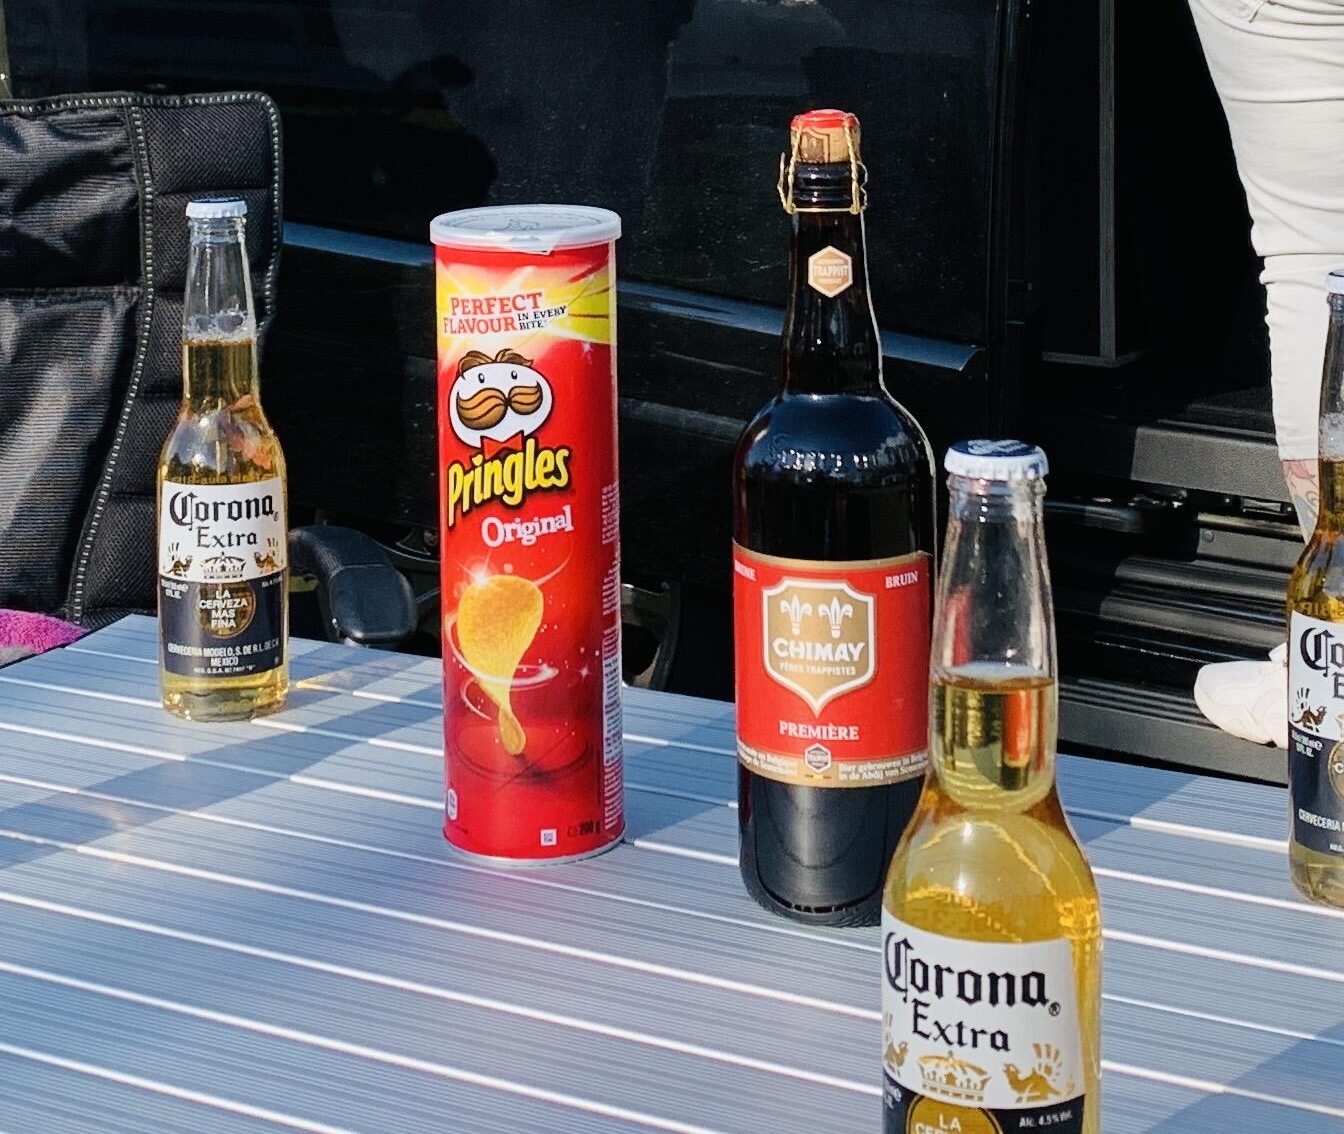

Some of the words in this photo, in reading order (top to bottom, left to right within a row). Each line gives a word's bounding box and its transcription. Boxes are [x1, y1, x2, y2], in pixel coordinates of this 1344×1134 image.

[450, 292, 543, 316] PERFECT
[517, 313, 529, 321] IN
[534, 305, 567, 320] EVERY
[443, 316, 518, 335] FLAVOUR
[519, 319, 544, 331] BITE
[448, 438, 570, 528] Pringles
[169, 491, 275, 531] Corona
[481, 504, 574, 547] Original
[196, 526, 258, 548] Extra
[885, 570, 918, 589] BRUIN
[199, 598, 249, 609] CERVEZA
[216, 589, 231, 599] LA
[211, 609, 236, 619] MAS
[211, 618, 236, 628] FINA
[772, 637, 866, 662] CHIMAY
[210, 656, 239, 667] MEXICO
[779, 720, 859, 741] PREMIÈRE
[1298, 808, 1341, 831] CERVECERIA
[884, 931, 1050, 1007] Corona
[911, 998, 1011, 1052] Extra
[938, 1113, 962, 1132] LA
